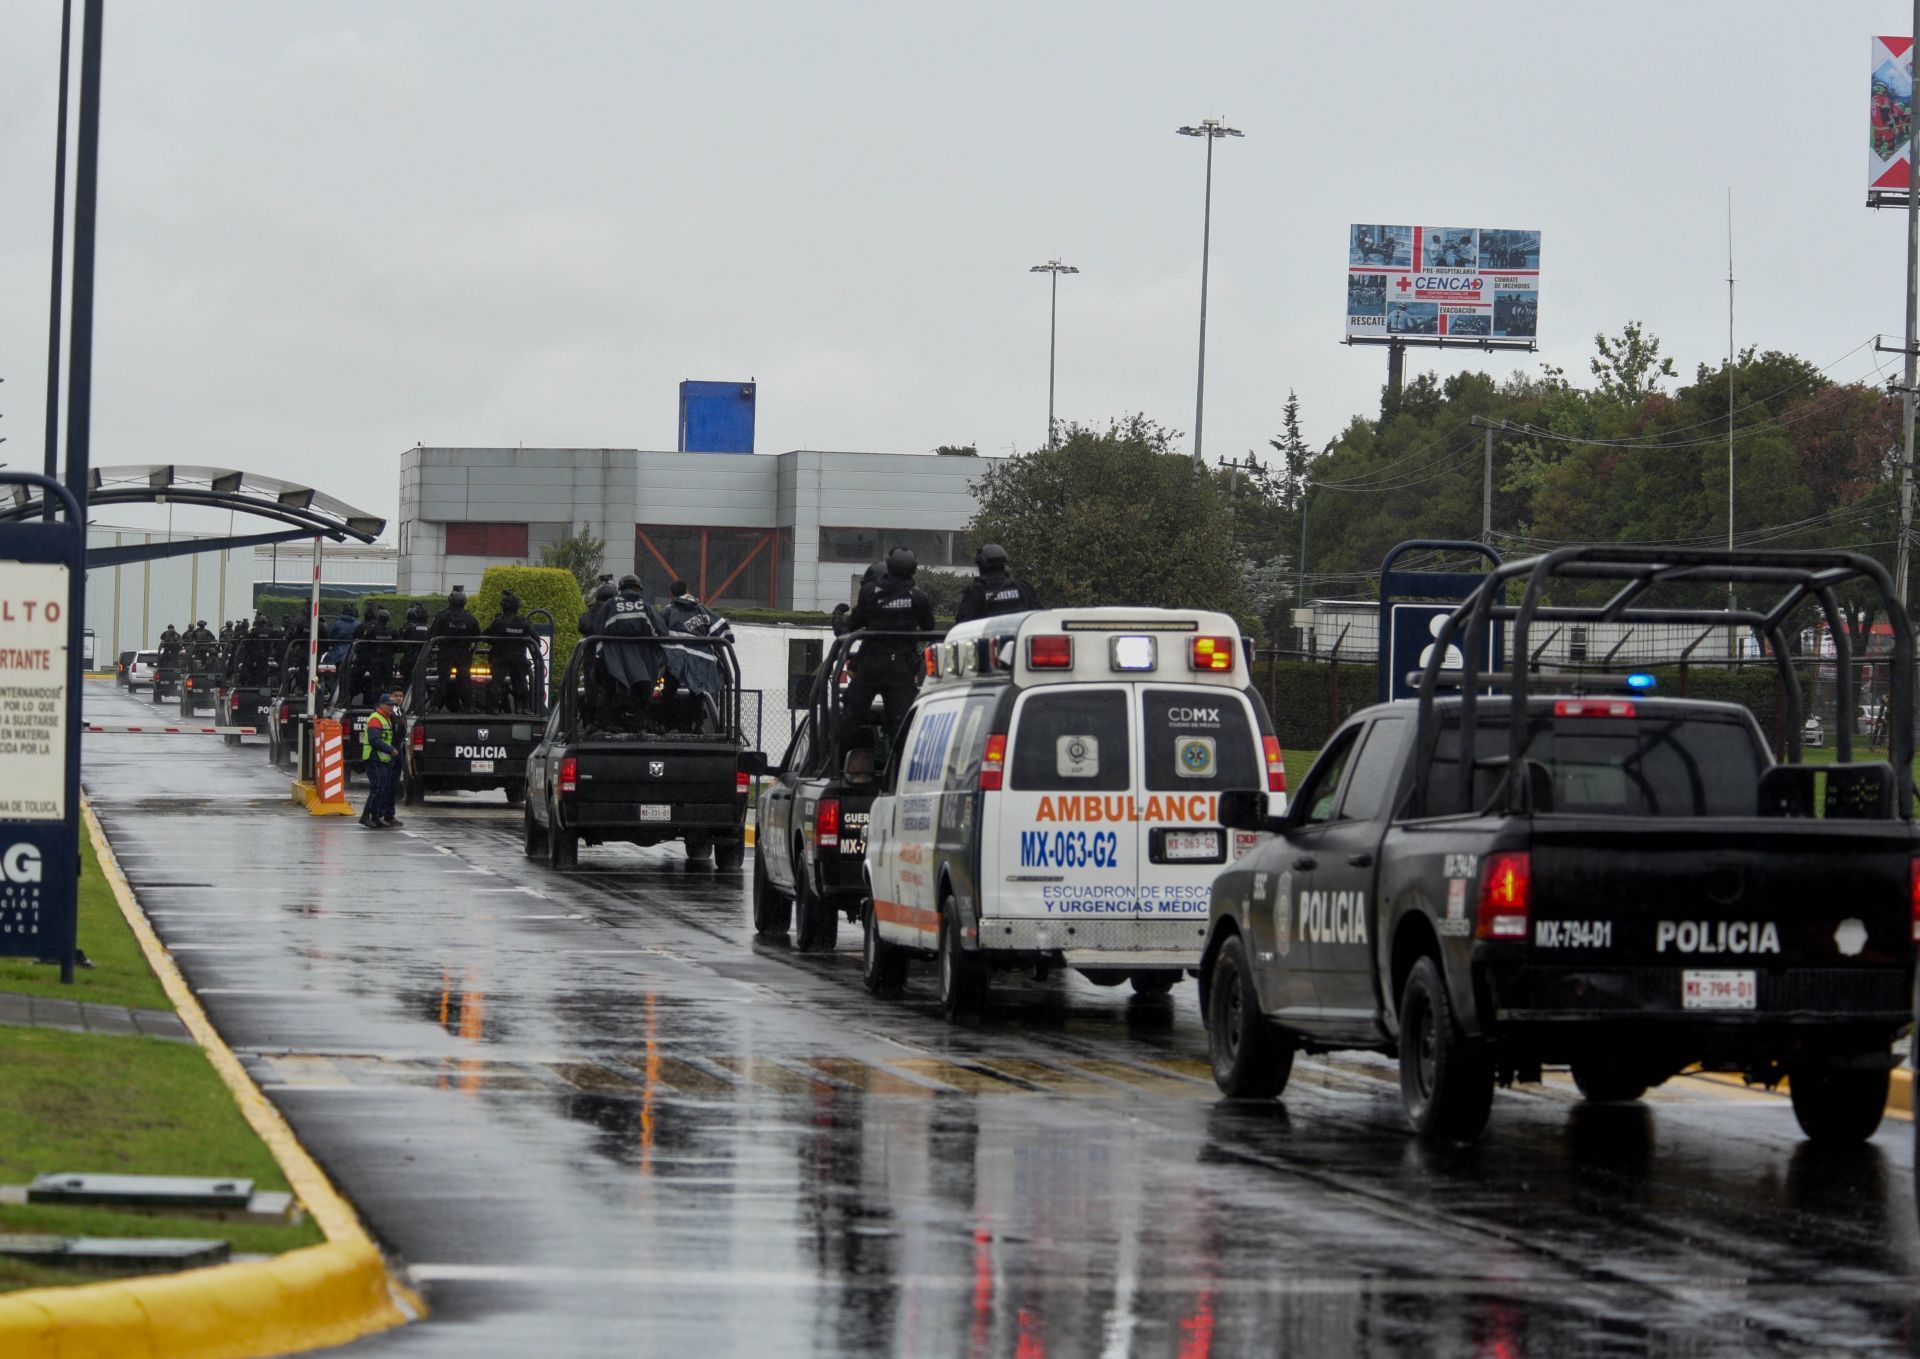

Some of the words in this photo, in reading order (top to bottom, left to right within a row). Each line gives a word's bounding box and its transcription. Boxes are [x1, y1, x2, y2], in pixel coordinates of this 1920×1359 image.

[1351, 316, 1386, 326] RESCATE
[616, 600, 645, 612] SSC
[38, 702, 56, 712] QUE
[12, 714, 59, 727] SUJETARSE
[1168, 708, 1220, 722] CDMX
[14, 730, 51, 742] MATERIA
[21, 743, 38, 755] POR
[39, 744, 51, 755] LA
[455, 746, 507, 759] POLICIA
[11, 801, 23, 812] DE
[25, 801, 58, 813] TOLUCA
[1021, 831, 1117, 868] MX-063-G2
[1043, 886, 1136, 899] ESCUADRON
[1141, 886, 1160, 898] DE
[1045, 901, 1056, 912] Y
[1060, 901, 1154, 913] URGENCIAS
[1299, 890, 1368, 944] POLICIA
[1534, 920, 1612, 948] MX-794-D1
[1656, 921, 1781, 953] POLICIA
